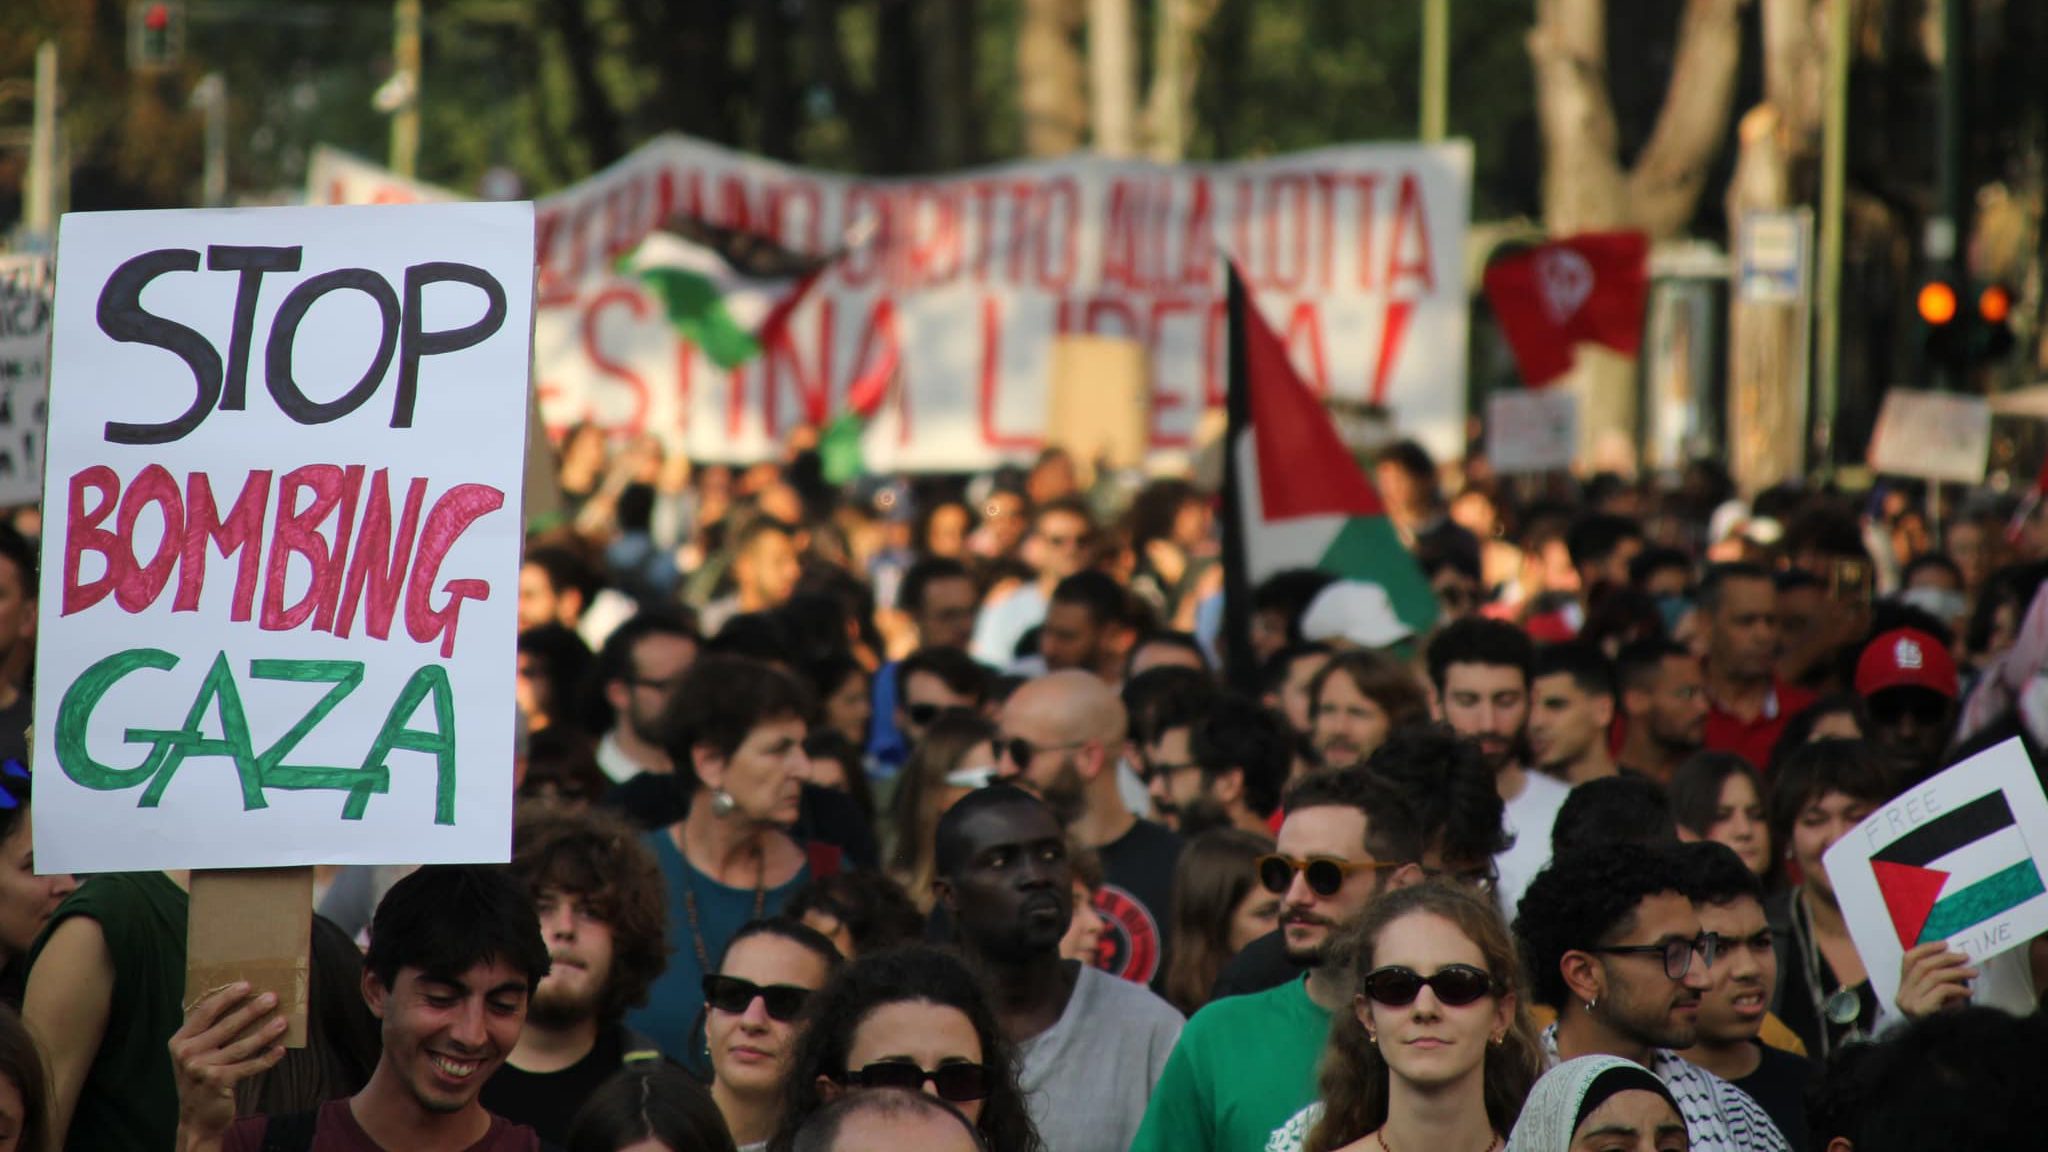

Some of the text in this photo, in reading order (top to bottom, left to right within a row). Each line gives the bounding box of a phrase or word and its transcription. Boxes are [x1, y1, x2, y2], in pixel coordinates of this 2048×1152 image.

[1235, 167, 1435, 294] LOTTA
[96, 245, 507, 445] STOP
[60, 463, 505, 658] BOMBING
[54, 648, 456, 825] GAZA
[1863, 787, 1943, 850] FREE
[1956, 921, 2012, 954] TINE
